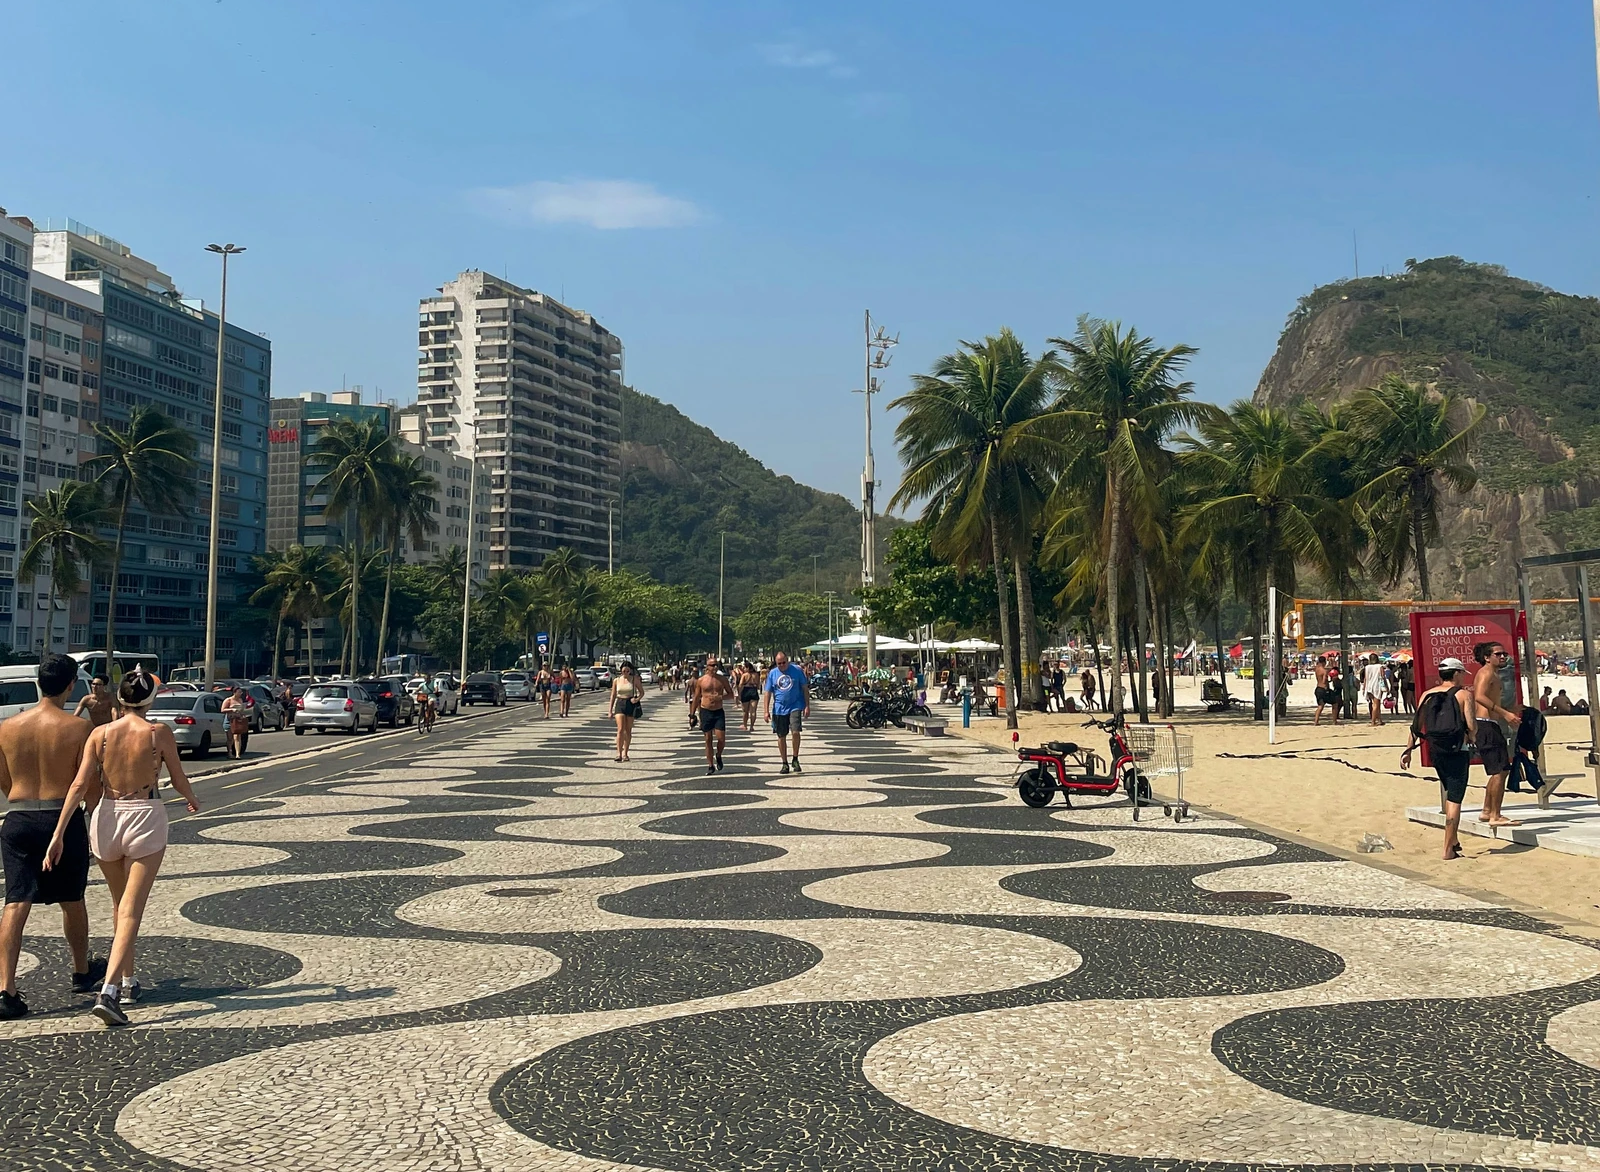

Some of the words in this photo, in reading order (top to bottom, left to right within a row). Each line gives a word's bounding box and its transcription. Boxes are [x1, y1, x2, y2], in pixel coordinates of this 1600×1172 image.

[268, 427, 297, 443] ARENA
[1430, 626, 1488, 636] SANTANDER.
[1431, 637, 1439, 646] O
[1440, 636, 1471, 646] BANCO
[1432, 647, 1446, 656] DO
[1447, 645, 1474, 655] CICLIS
